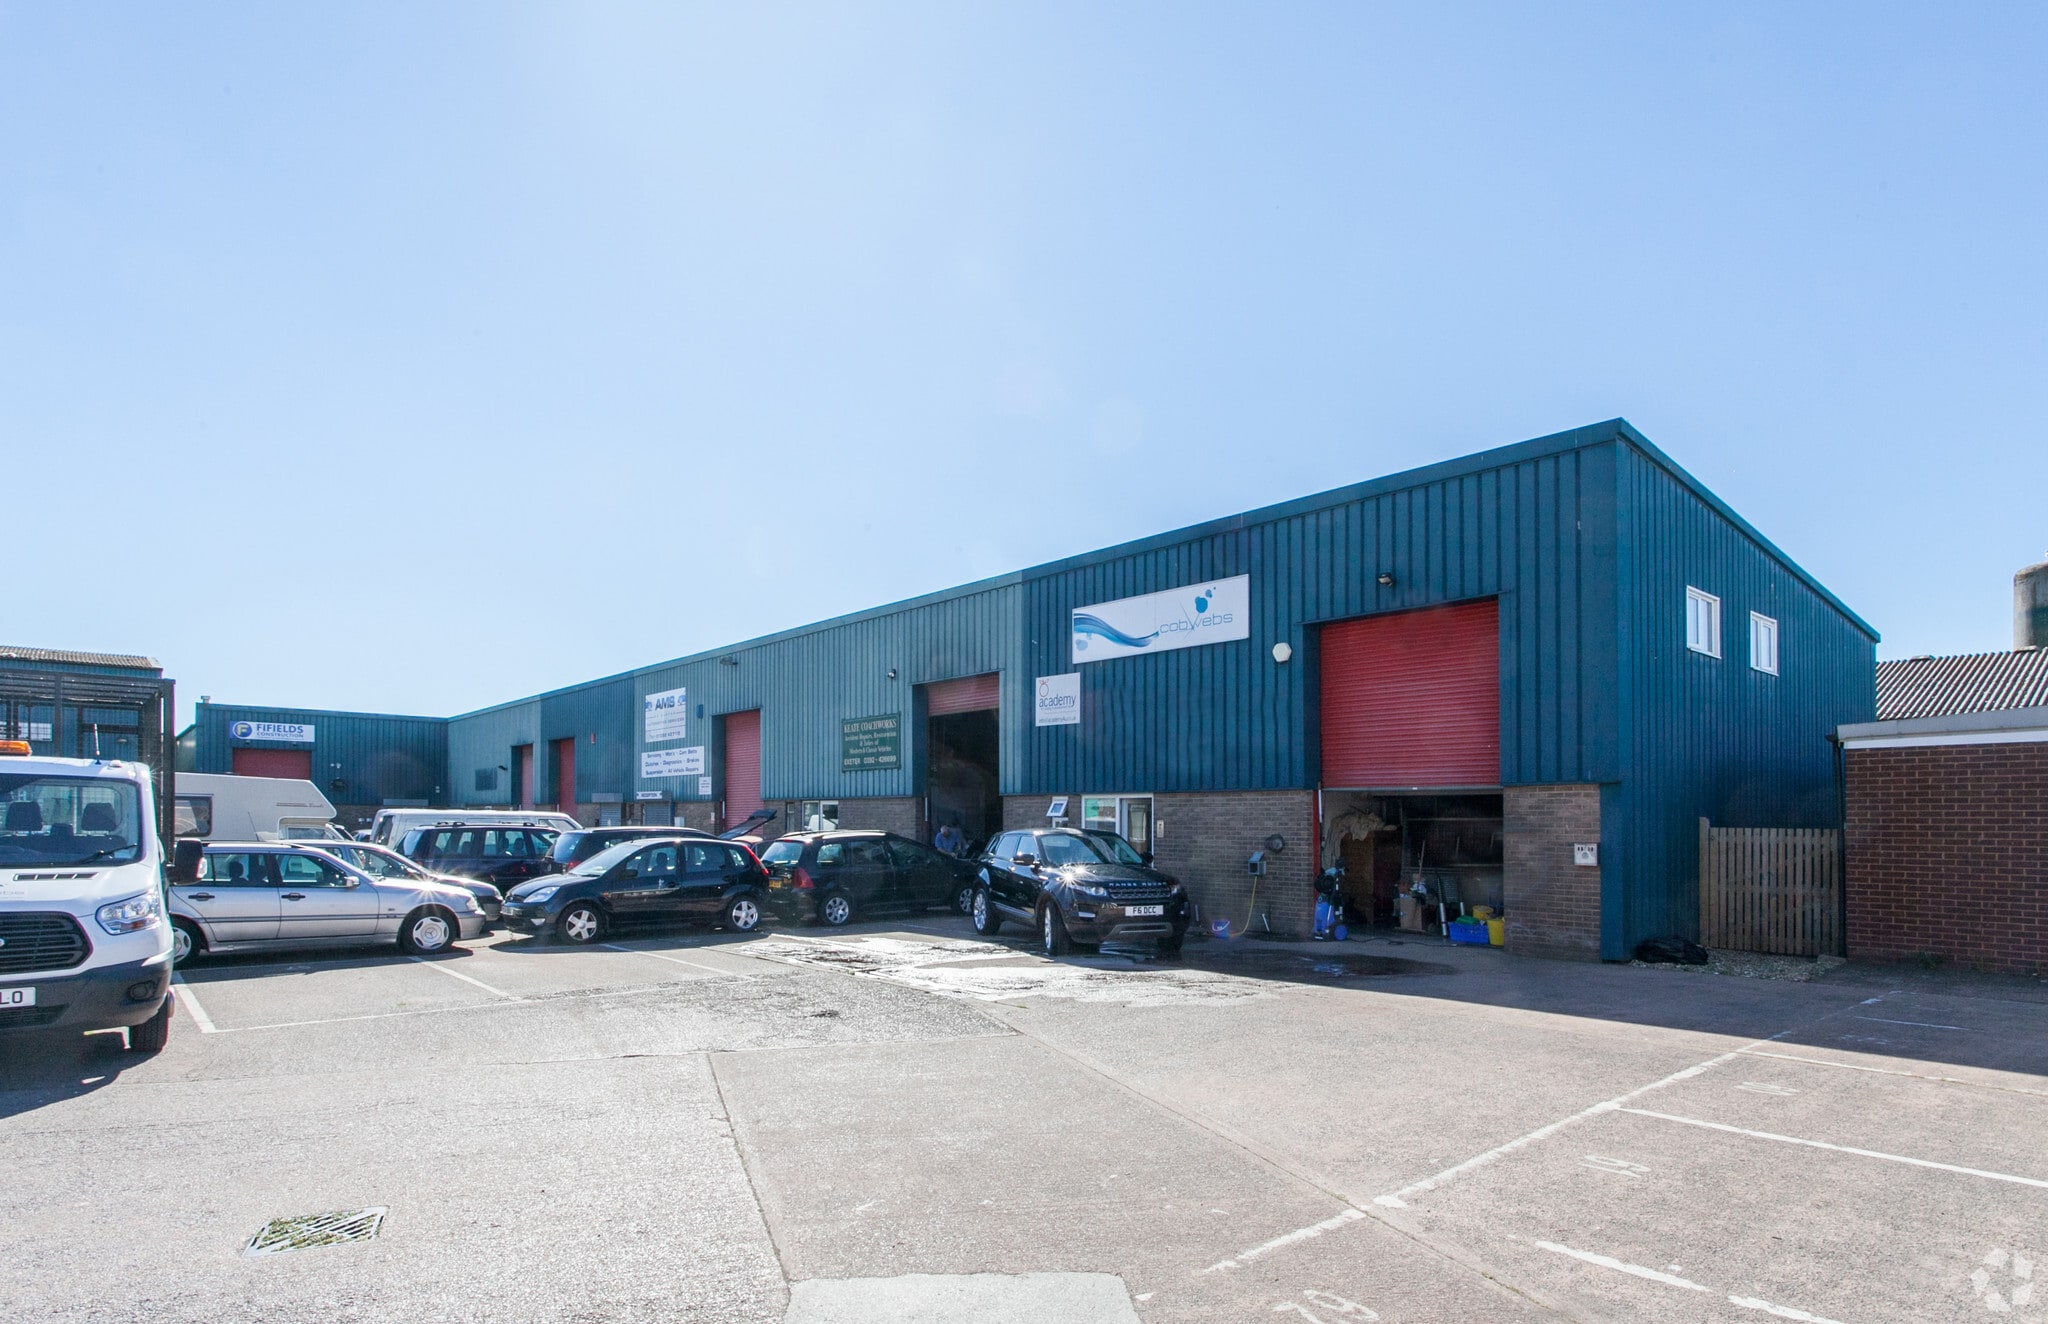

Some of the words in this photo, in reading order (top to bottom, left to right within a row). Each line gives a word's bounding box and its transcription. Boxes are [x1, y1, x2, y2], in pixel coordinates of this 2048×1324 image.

[1038, 693, 1077, 708] academy
[256, 724, 304, 733] FIFIELDS
[861, 719, 896, 731] COACHWORKS
[844, 757, 861, 766] EXETER
[1132, 906, 1142, 914] F6
[1143, 906, 1156, 914] DCC
